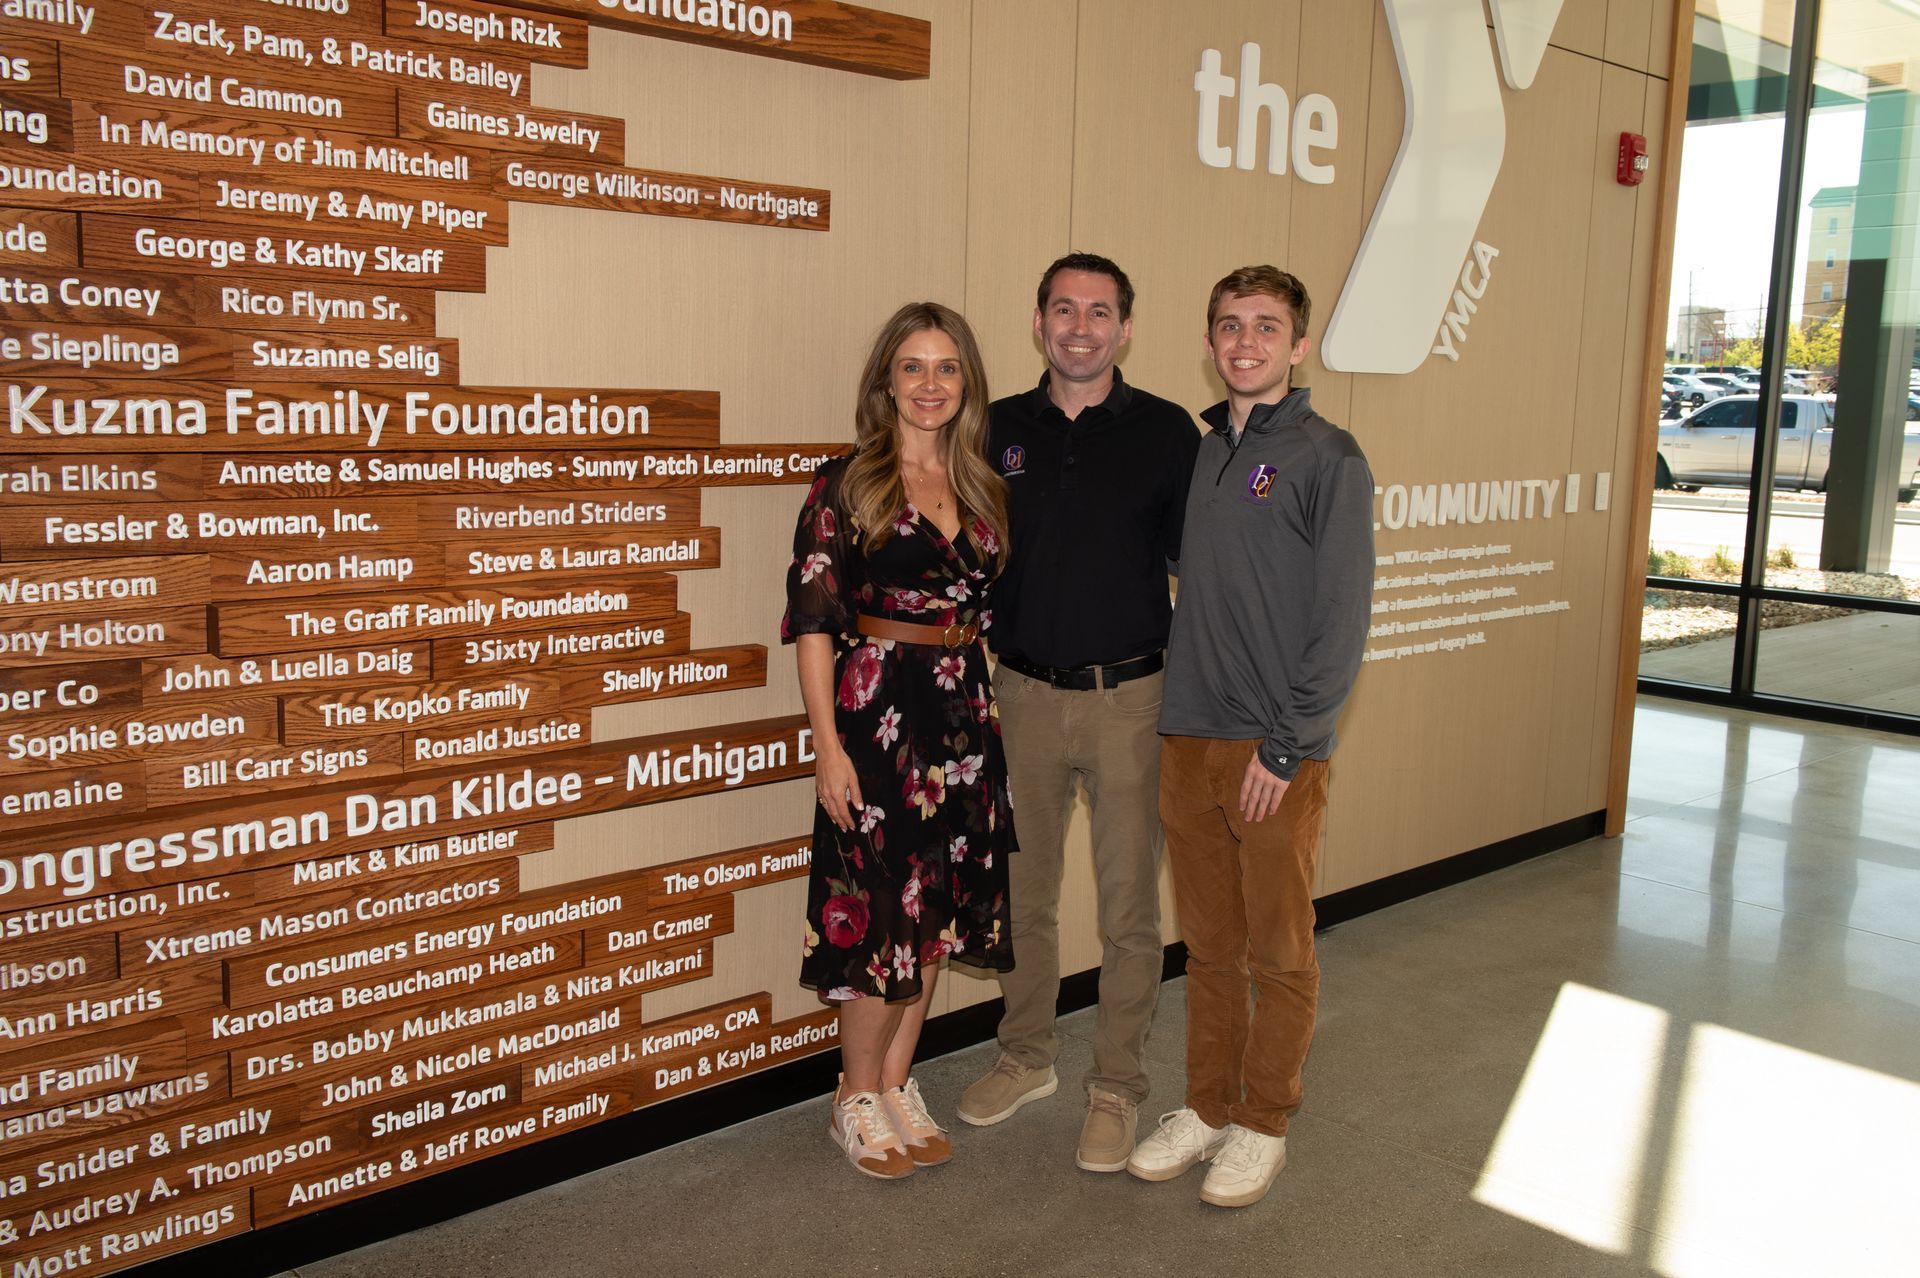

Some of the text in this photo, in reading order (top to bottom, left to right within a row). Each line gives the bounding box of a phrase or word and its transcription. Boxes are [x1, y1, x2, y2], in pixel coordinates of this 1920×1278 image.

[415, 0, 562, 49] Joseph Rizk
[153, 11, 523, 97] Zack, Pam, & Patrick Bailey
[124, 65, 342, 119] David Cammon
[1194, 42, 1338, 184] the
[100, 115, 469, 181] In Memory of Jim Mitchell
[427, 101, 601, 153] Gaines Jewelry
[215, 179, 488, 234] Jeremy & Amy Piper
[506, 162, 818, 220] George Wilkinson Northgate
[135, 228, 444, 276] George & Kathy Skaff
[59, 277, 161, 317] Coney
[221, 287, 408, 325] Rico Flynn Sr.
[1431, 240, 1500, 363] YMCA
[30, 332, 179, 371] Sieplinga
[252, 340, 440, 377] Suzanne Selig
[7, 384, 649, 447] Kuzma Family Foundation
[61, 464, 157, 492] Elkins
[218, 453, 784, 485] Annette & Samuel Hughes Sunny Patch Learning
[45, 508, 380, 544] Fessler & Bowman, Inc.
[456, 500, 667, 530] Riverbend Striders
[246, 554, 414, 585] Aaron Hamp
[468, 539, 700, 575] Steve & Laura Randall
[59, 619, 165, 649] Holton
[284, 590, 629, 637] The Graff Family Foundation
[464, 625, 665, 664] 3Sixty Interactive
[161, 647, 414, 693] John & Luella Daig
[602, 661, 728, 693] Shelly Hilton
[319, 682, 530, 727] The Kopko Family
[7, 713, 245, 761] Sophie Bawden
[415, 720, 581, 761] Ronald Justice
[183, 748, 368, 789] Bill Carr Signs
[345, 794, 437, 837] Dan
[452, 768, 582, 820] Kildee
[626, 741, 787, 792] Michigan
[293, 830, 519, 886] Mark & Kim Butler
[663, 872, 700, 895] The
[703, 862, 757, 886] Olson
[145, 877, 500, 964] Xtreme Mason Contractors
[265, 895, 622, 987] Consumers Energy Foundation
[608, 914, 713, 952] Dan Czmer
[66, 987, 163, 1027] Harris
[212, 942, 555, 1040] Karolatta Beauchamp Heath
[247, 948, 702, 1080] Drs. Bobby Mukkamala & Nita Kulkarni
[322, 1006, 620, 1107] John & Nicole MacDonald
[534, 1007, 760, 1088] Michael J. Krampe, CPA
[655, 1017, 838, 1090] Dan & Kayla Redford
[38, 1053, 139, 1096] Family
[371, 1084, 506, 1138] Sheila Zorn
[37, 1107, 272, 1188] Snider & Family
[287, 1093, 610, 1207] Annette & Jeff Rowe Family
[28, 1135, 331, 1237] Audrey A. Thompson
[101, 1205, 235, 1259] Rawlings
